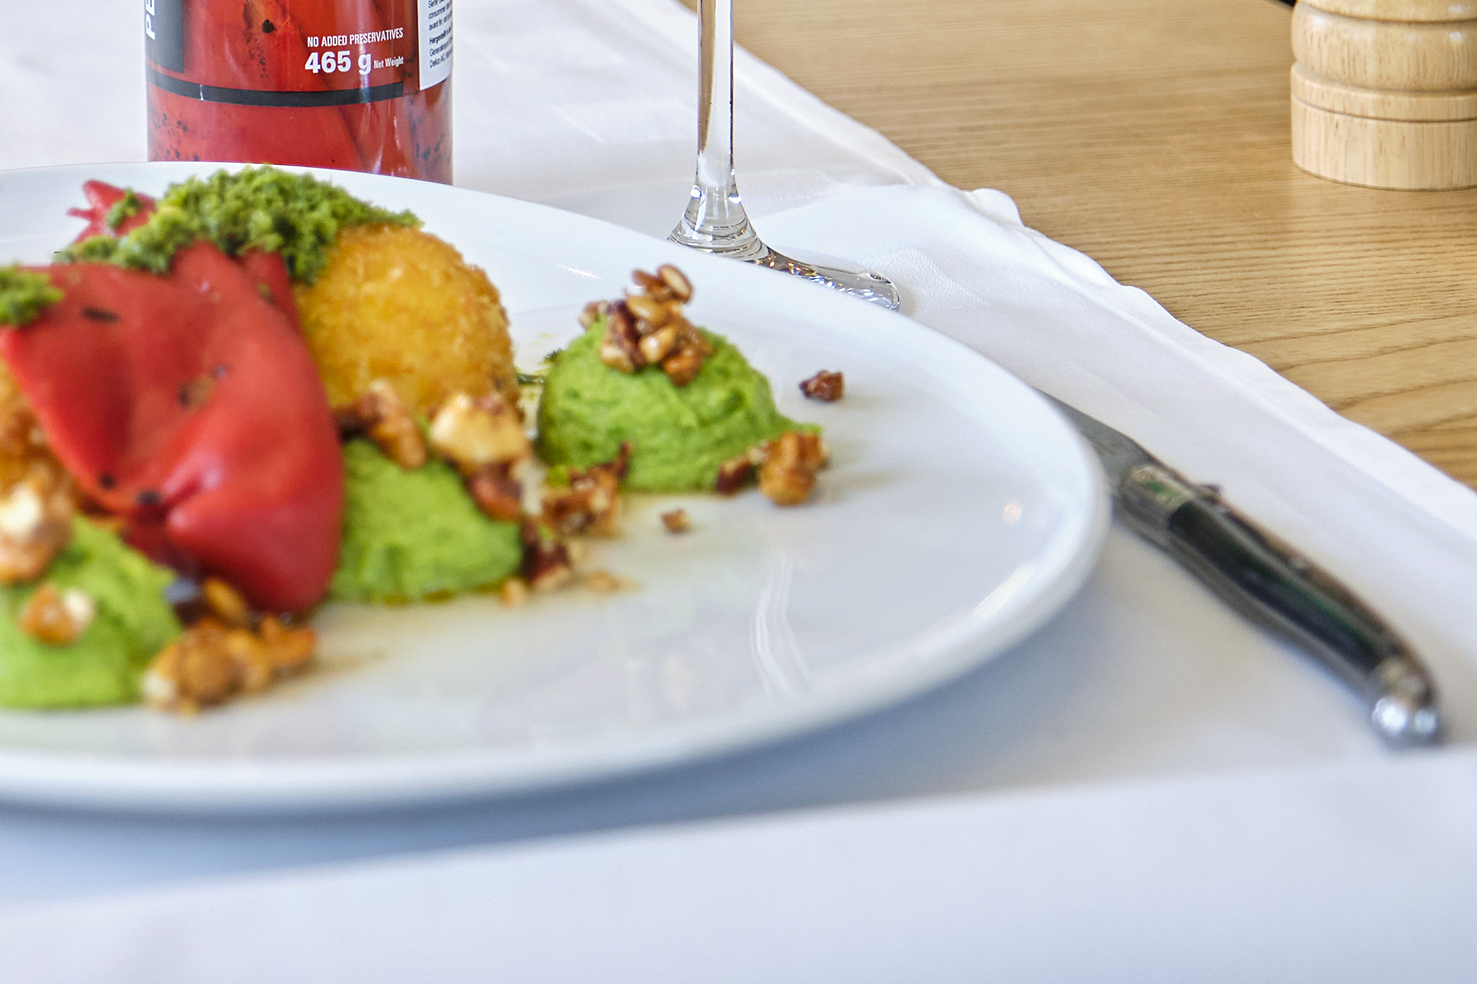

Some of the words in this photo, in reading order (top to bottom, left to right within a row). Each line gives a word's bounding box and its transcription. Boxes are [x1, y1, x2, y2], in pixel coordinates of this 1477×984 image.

[307, 36, 319, 47] NO
[321, 35, 347, 47] ADDED
[349, 27, 404, 45] PRESERVATIVES
[304, 50, 352, 74] 465
[357, 53, 372, 75] g
[373, 59, 384, 69] Net
[385, 56, 404, 68] Weight
